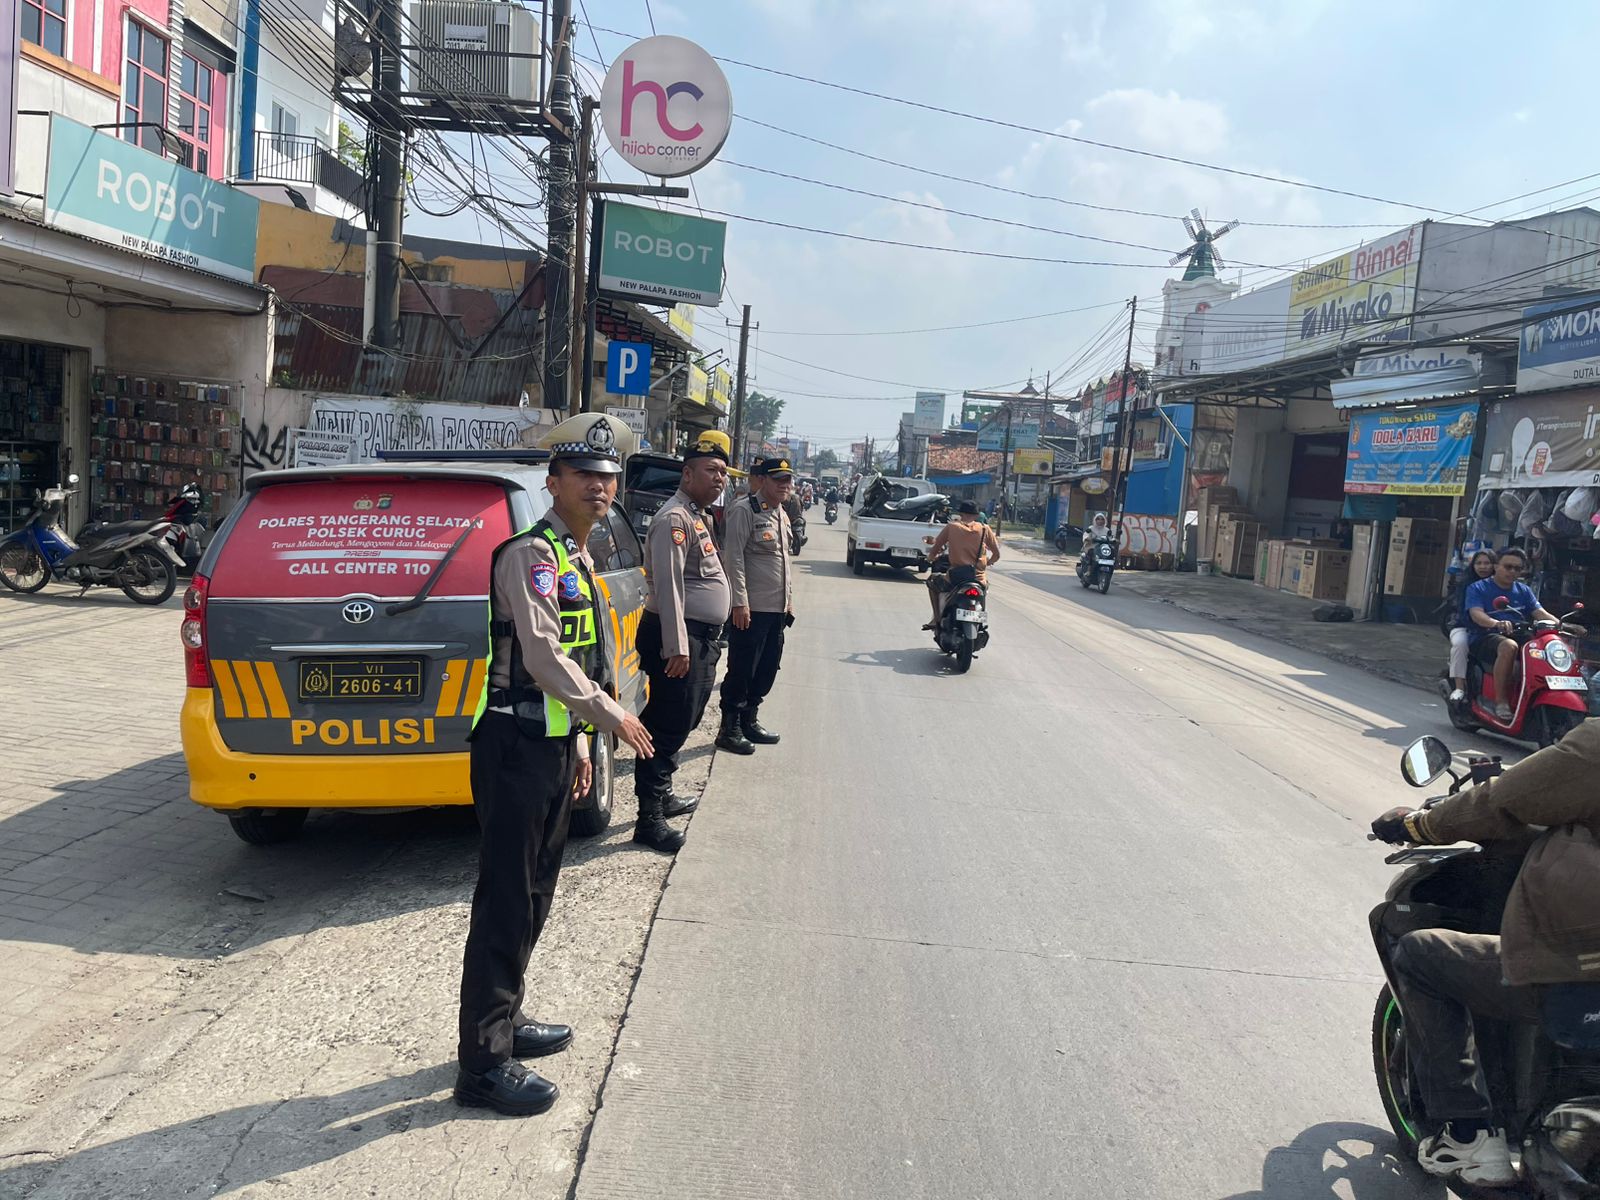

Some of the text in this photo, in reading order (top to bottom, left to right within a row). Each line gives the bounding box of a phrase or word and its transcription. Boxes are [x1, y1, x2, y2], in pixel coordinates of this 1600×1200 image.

[97, 158, 226, 238] ROBOT
[121, 234, 200, 267] NEW PALAPA FASHION
[614, 230, 713, 265] ROBOT
[1355, 228, 1415, 281] Rinnai
[1297, 259, 1344, 291] SHIMIZU
[619, 280, 702, 301] NEW PALAPA FASHION
[1318, 284, 1393, 340] Miyako
[618, 347, 638, 388] P
[1573, 367, 1594, 380] DUTA
[357, 411, 436, 458] PALAPA
[442, 416, 524, 450] FASHIO
[1372, 426, 1440, 446] IDOLA BARU
[298, 439, 330, 452] PALAPA
[259, 515, 484, 529] POLRES TANGERANG SELATAN
[307, 527, 426, 539] POLSEK CURUG
[272, 541, 296, 549] Terus
[297, 539, 345, 549] Melindungi,
[346, 540, 395, 549] Mengayomi
[396, 540, 413, 548] dan
[343, 550, 381, 558] PRESISI
[288, 561, 431, 575] CALL CENTER 110
[366, 665, 384, 674] VII
[340, 678, 413, 694] 2606-41
[291, 718, 435, 746] POLISI
